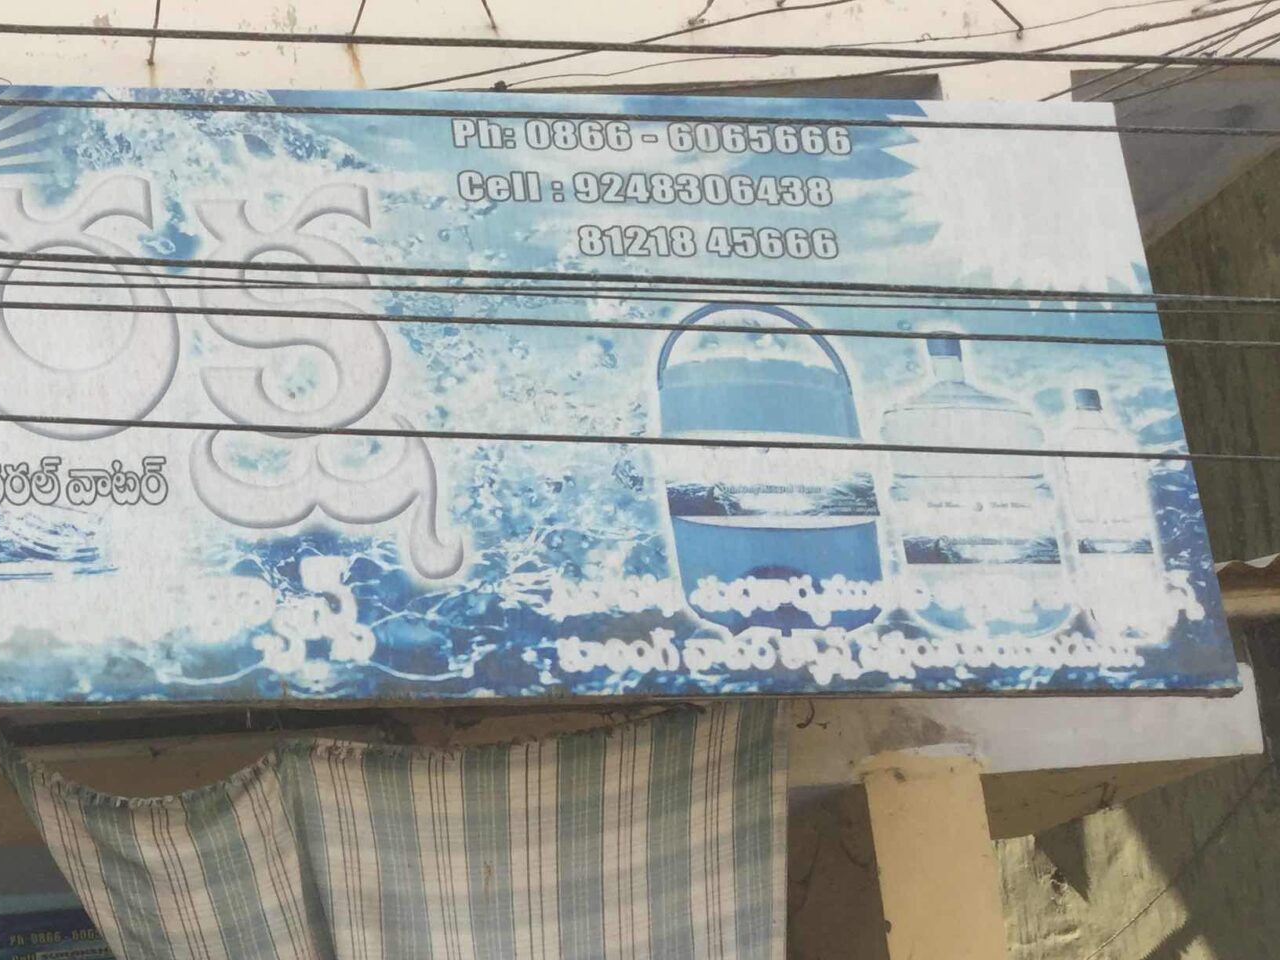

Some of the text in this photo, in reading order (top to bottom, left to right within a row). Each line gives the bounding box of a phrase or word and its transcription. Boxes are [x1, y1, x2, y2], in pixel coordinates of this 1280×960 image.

[452, 118, 517, 150] Ph:
[524, 119, 632, 152] 0866
[667, 121, 852, 156] 6065666
[457, 170, 542, 203] Cell
[572, 172, 833, 208] 9248306438
[577, 224, 840, 260] 81218 45666
[65, 455, 169, 506] వాటర్
